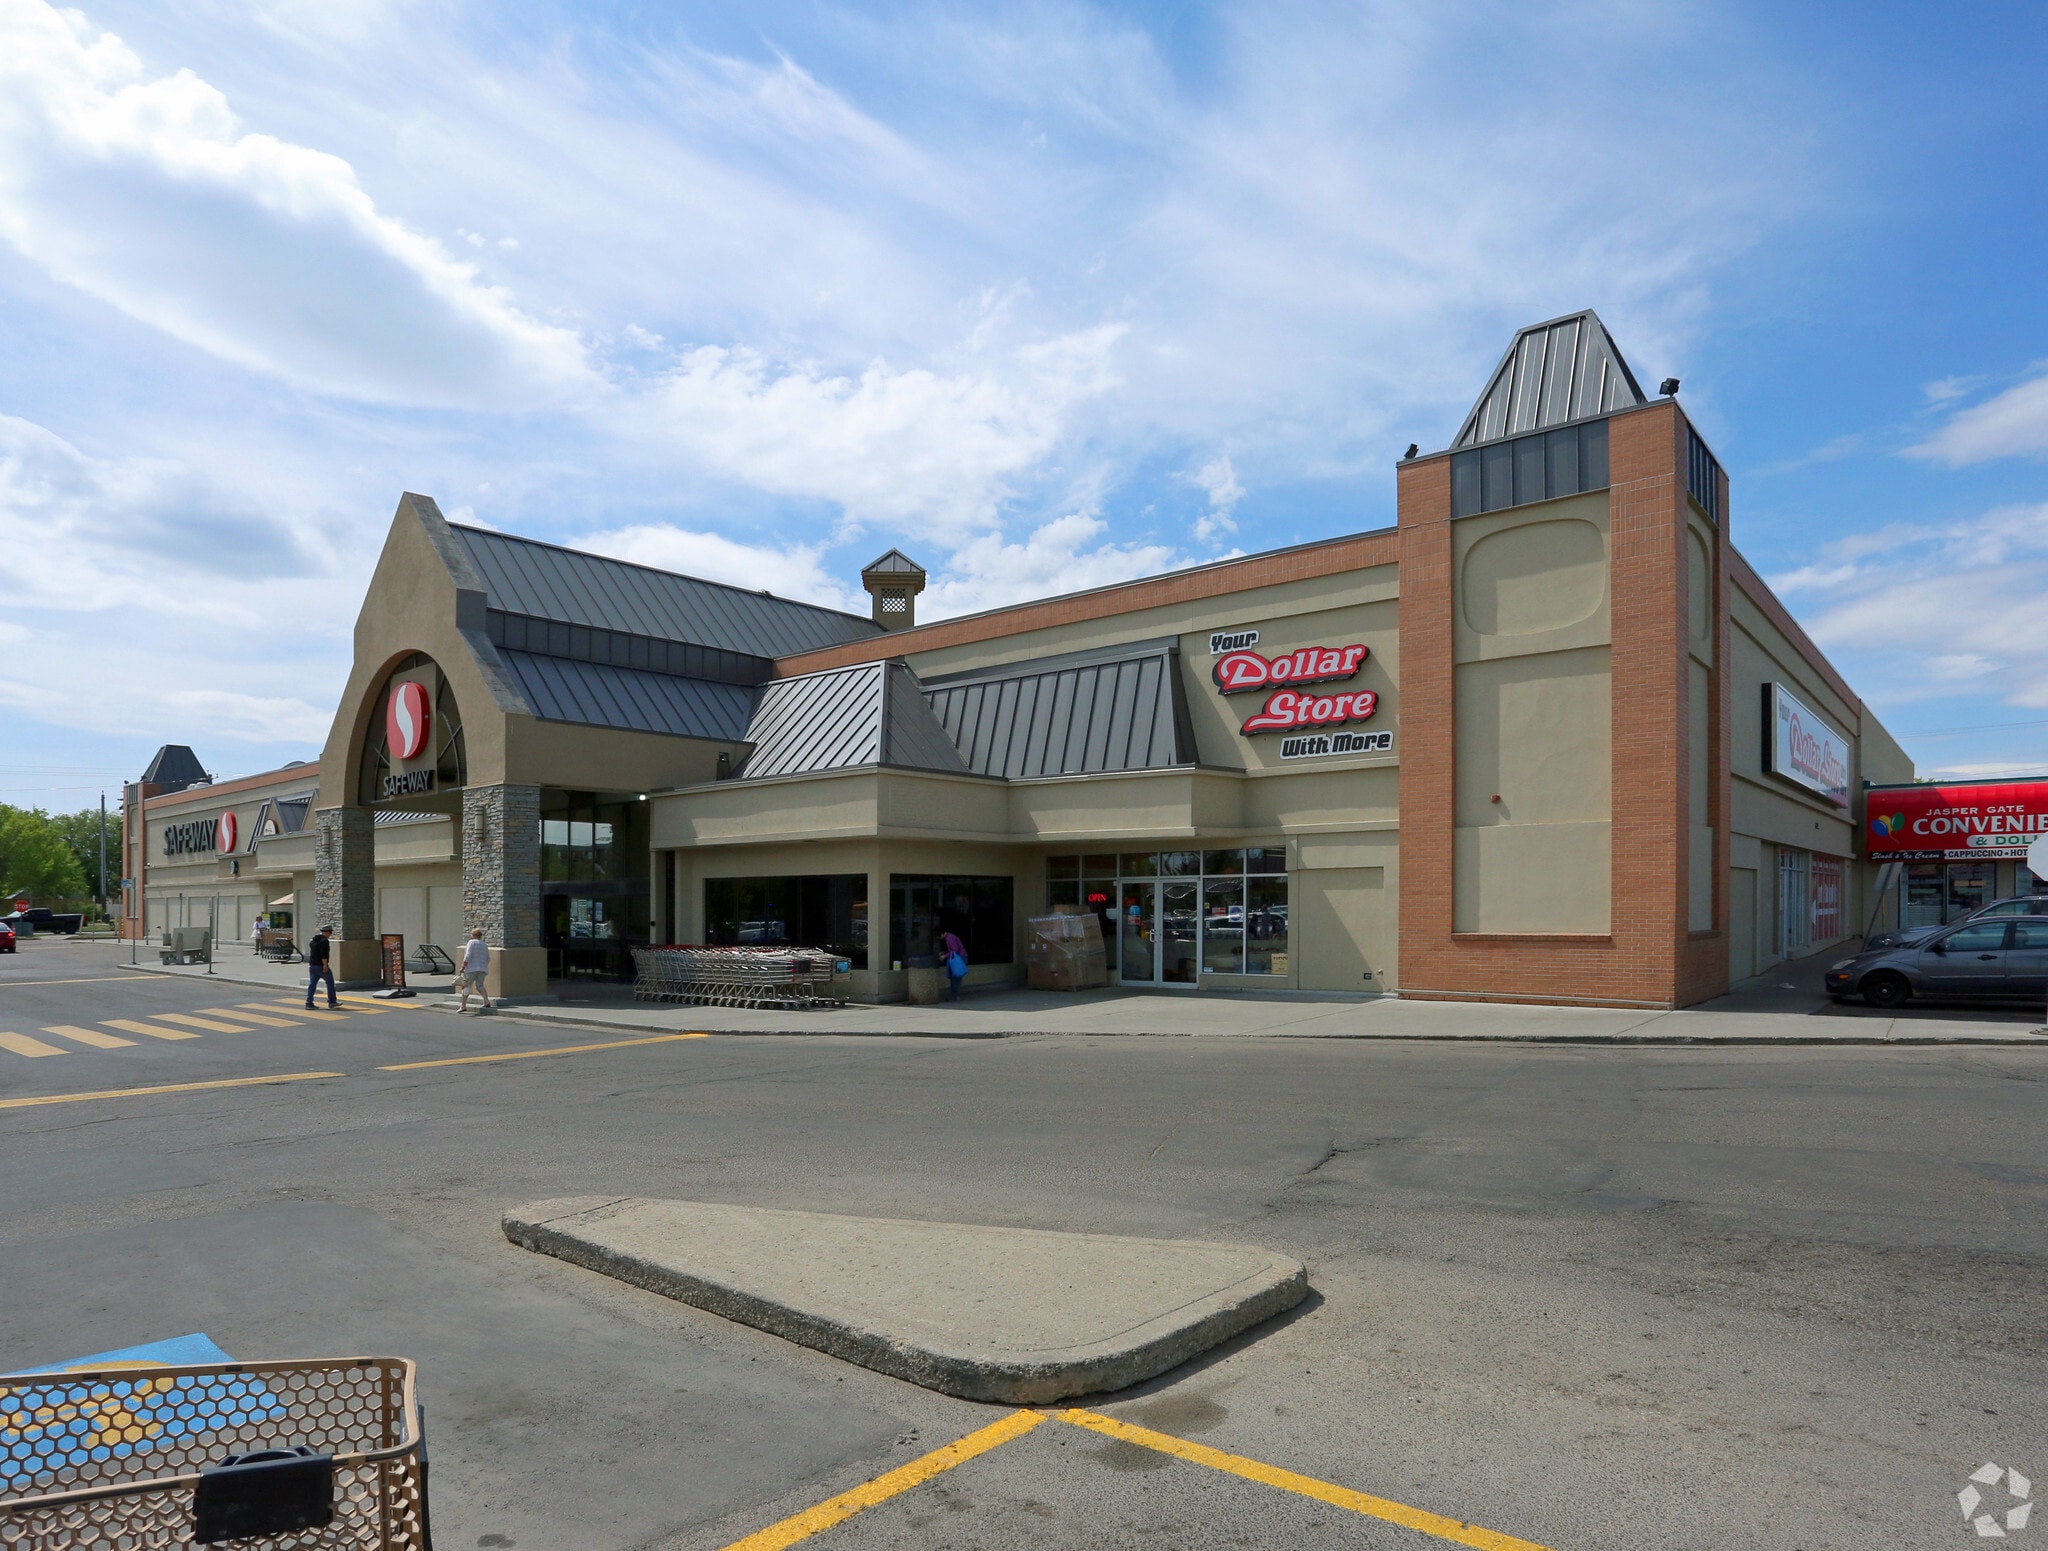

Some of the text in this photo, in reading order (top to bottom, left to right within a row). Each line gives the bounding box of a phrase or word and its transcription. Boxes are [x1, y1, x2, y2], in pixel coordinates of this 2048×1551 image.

[1211, 631, 1257, 652] Your
[1218, 648, 1364, 689] Dollar
[1246, 691, 1375, 730] Store
[1281, 733, 1391, 757] With More
[384, 770, 432, 796] SAFEWAY
[1926, 805, 2024, 816] JASPER GATE
[1912, 814, 2048, 835] CONVENIE
[164, 819, 218, 856] SAFEWAY
[1975, 836, 1987, 846] &
[1914, 851, 1940, 859] Cream
[1948, 849, 2003, 858] CAPPUCCINO
[2010, 849, 2028, 857] HOT
[1088, 893, 1106, 902] OPEN
